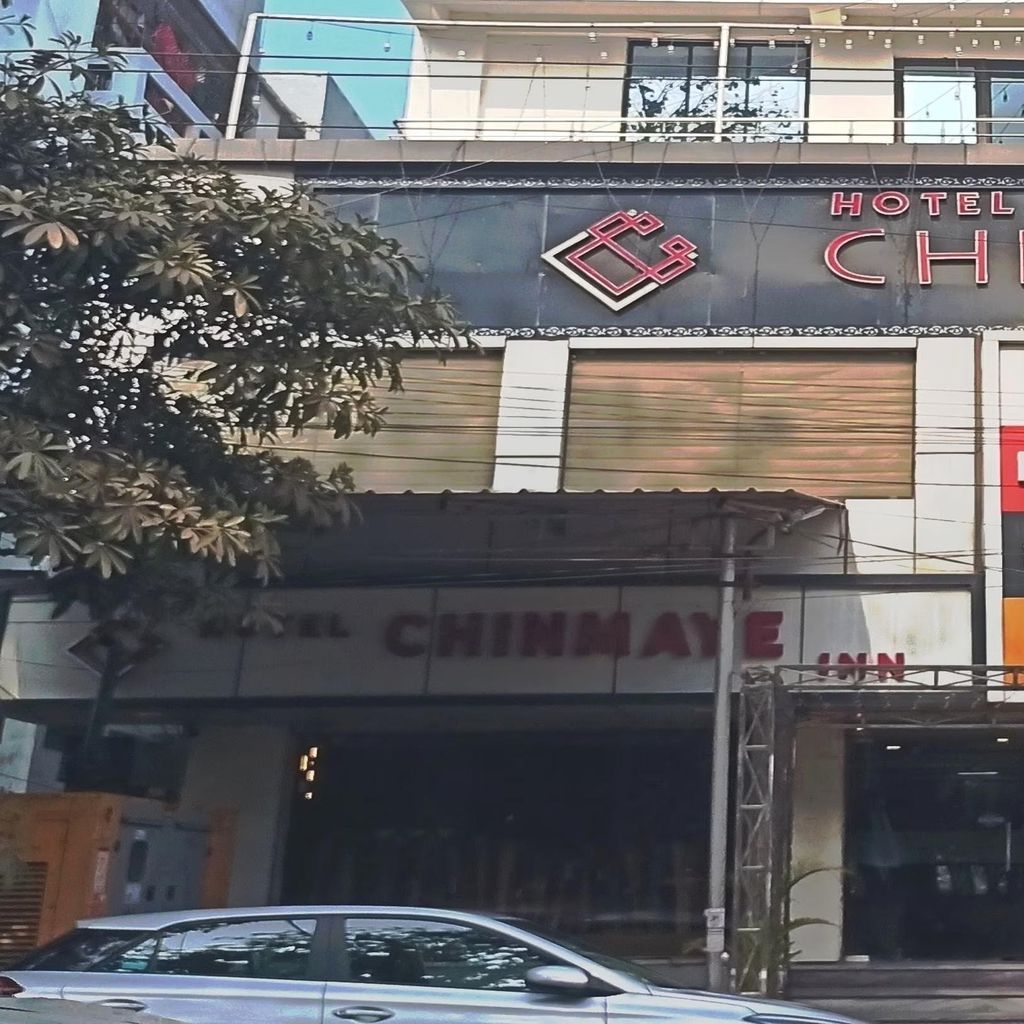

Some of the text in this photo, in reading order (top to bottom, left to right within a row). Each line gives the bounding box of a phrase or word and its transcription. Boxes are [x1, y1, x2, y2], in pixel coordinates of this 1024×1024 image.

[830, 191, 1015, 217] HOTEL
[384, 611, 784, 658] CHINMAYE
[817, 652, 906, 682] INN
